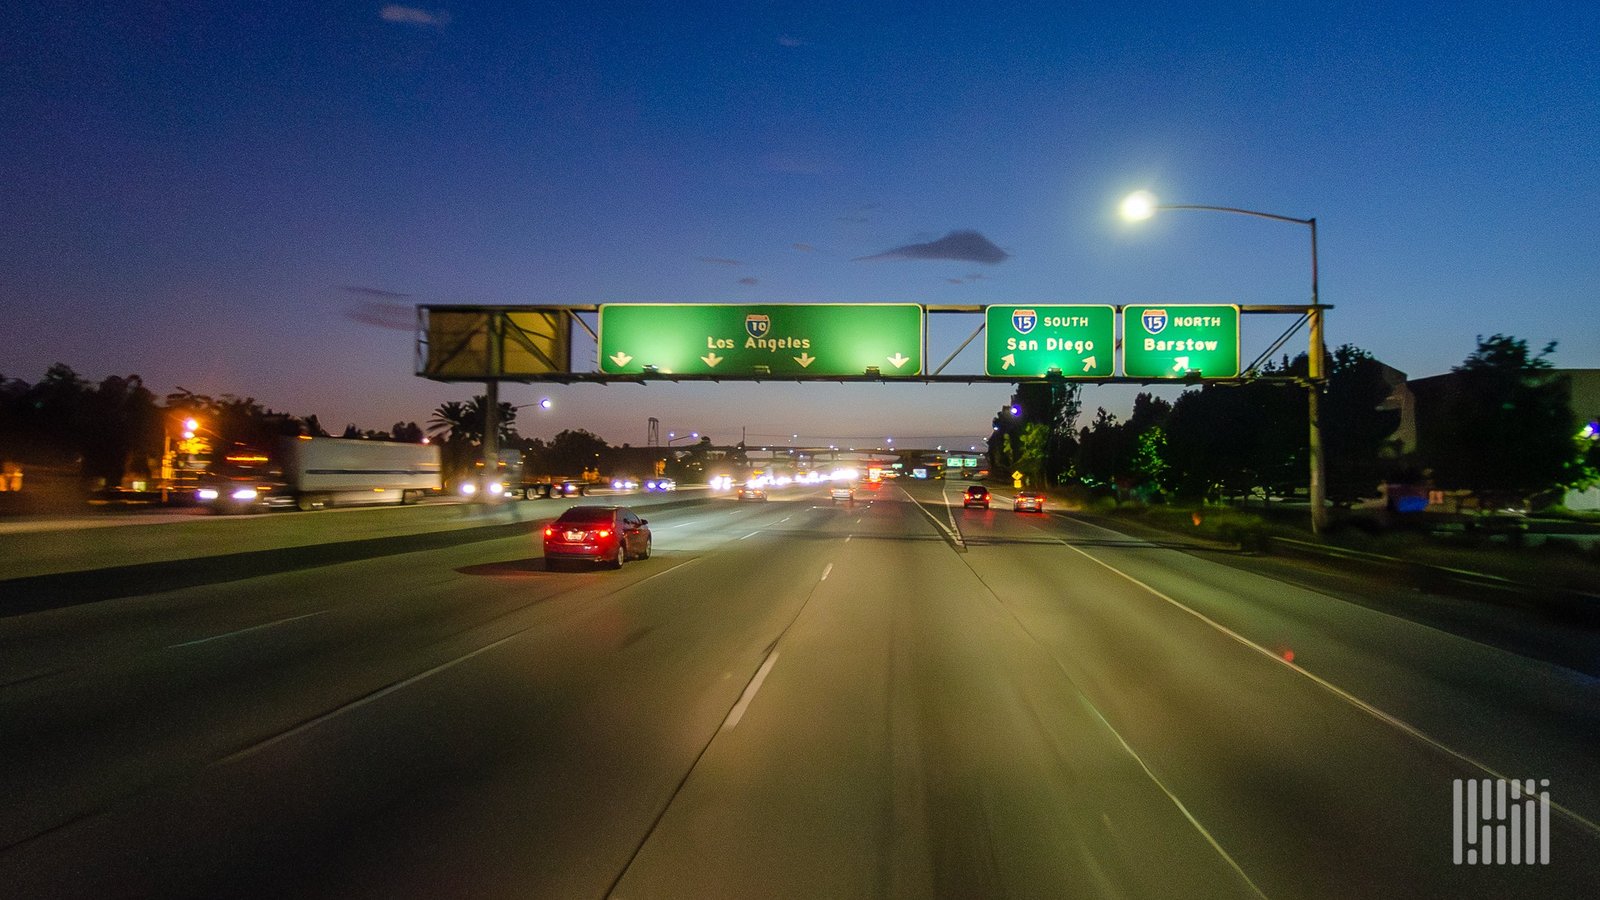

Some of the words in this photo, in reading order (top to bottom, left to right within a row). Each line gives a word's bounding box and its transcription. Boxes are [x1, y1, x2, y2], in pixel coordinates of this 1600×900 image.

[752, 321, 767, 331] 10
[1017, 317, 1032, 329] 15
[1043, 316, 1089, 327] SOUTH
[1147, 317, 1163, 329] 15
[1173, 316, 1221, 327] NORTH
[707, 336, 735, 349] Los
[744, 336, 811, 353] Angeles
[1006, 337, 1039, 351] San
[1046, 337, 1094, 355] Diego
[1143, 337, 1219, 351] Barstow
